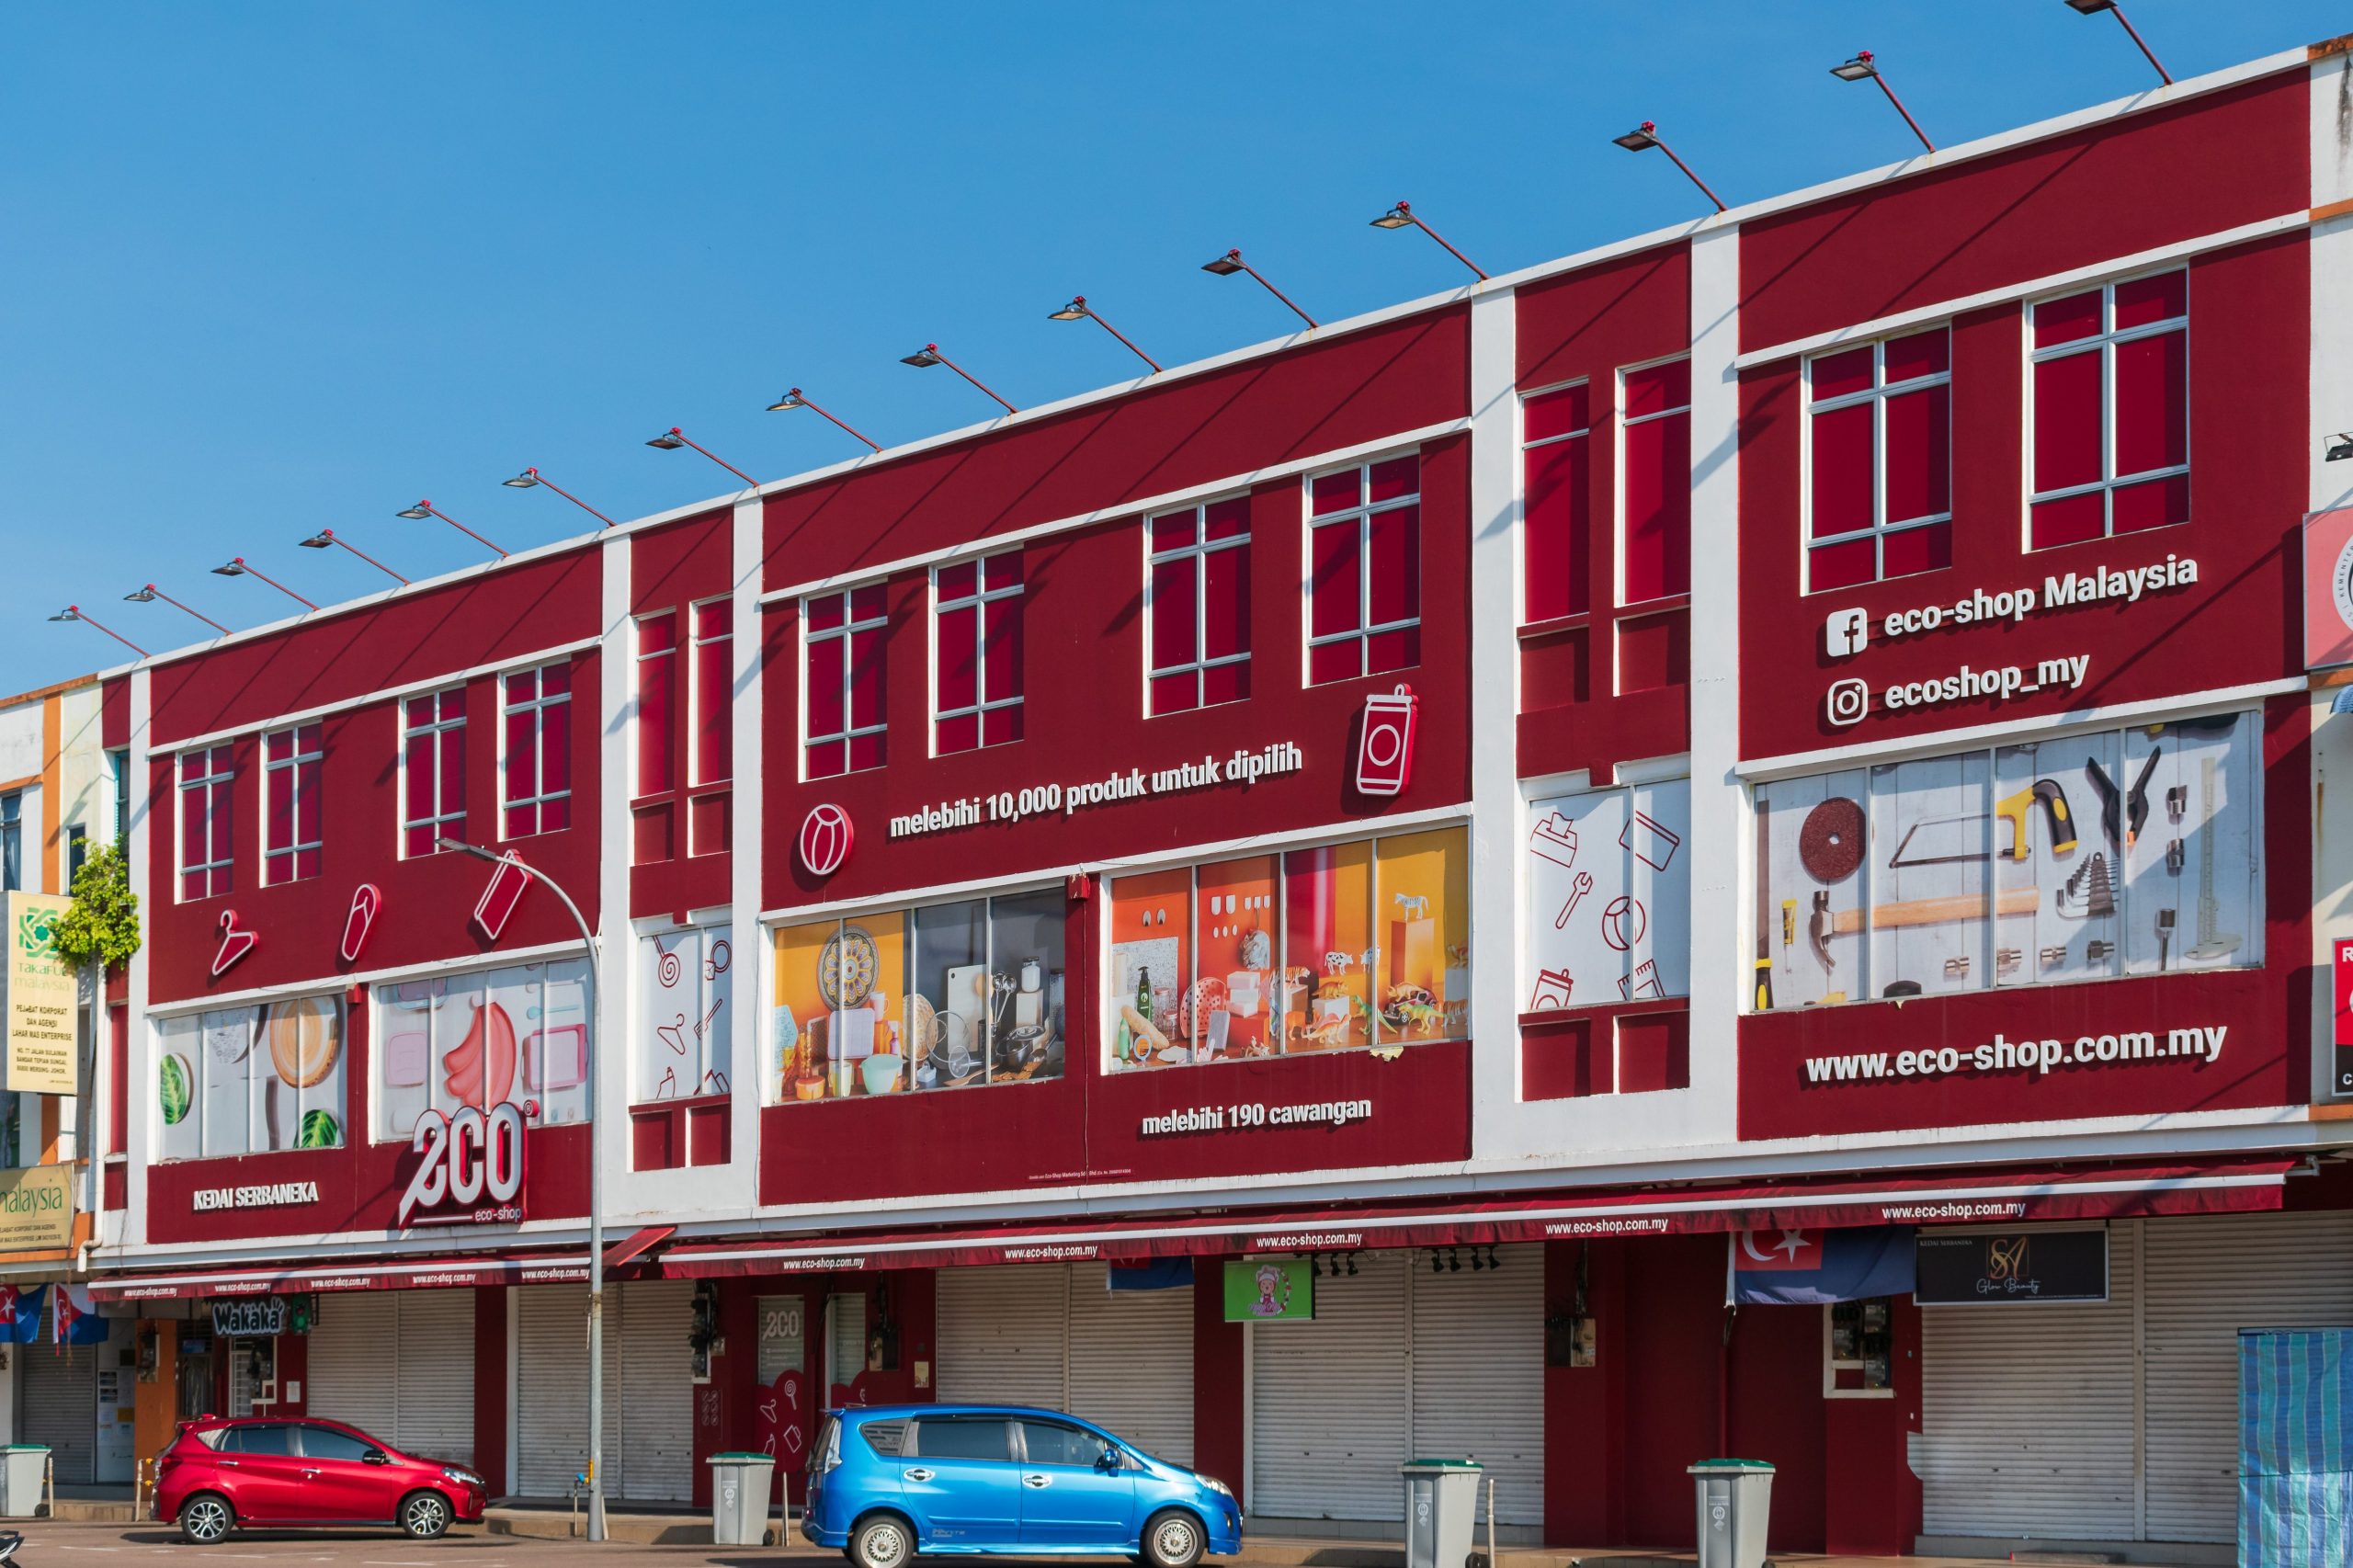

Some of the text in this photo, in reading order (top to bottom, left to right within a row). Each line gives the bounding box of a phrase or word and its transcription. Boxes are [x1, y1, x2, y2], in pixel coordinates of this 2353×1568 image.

[1883, 585, 2036, 637] eco-shop
[2044, 553, 2199, 608] Malaysia
[1884, 653, 2090, 710] ecoshop_my
[890, 741, 1303, 837] melebihi 10,000 produk untuk dipilih
[1805, 1025, 2228, 1083] www.eco-shop.com.my
[1142, 1099, 1372, 1135] melebihi 190 cawangan
[193, 1181, 320, 1210] KEDAI SERBANEKA
[474, 1205, 522, 1222] eco-shop
[1881, 1202, 2027, 1220] www.eco-shop.com.my
[1545, 1216, 1669, 1235] www.eco-shop.com.my
[1005, 1244, 1098, 1260] www.eco-shop.com.my
[1256, 1232, 1363, 1249] www.eco-shop.com.my
[783, 1256, 866, 1270] www.eco-shop.com.my
[2004, 1277, 2040, 1294] Beauty
[212, 1299, 283, 1336] Wakaka
